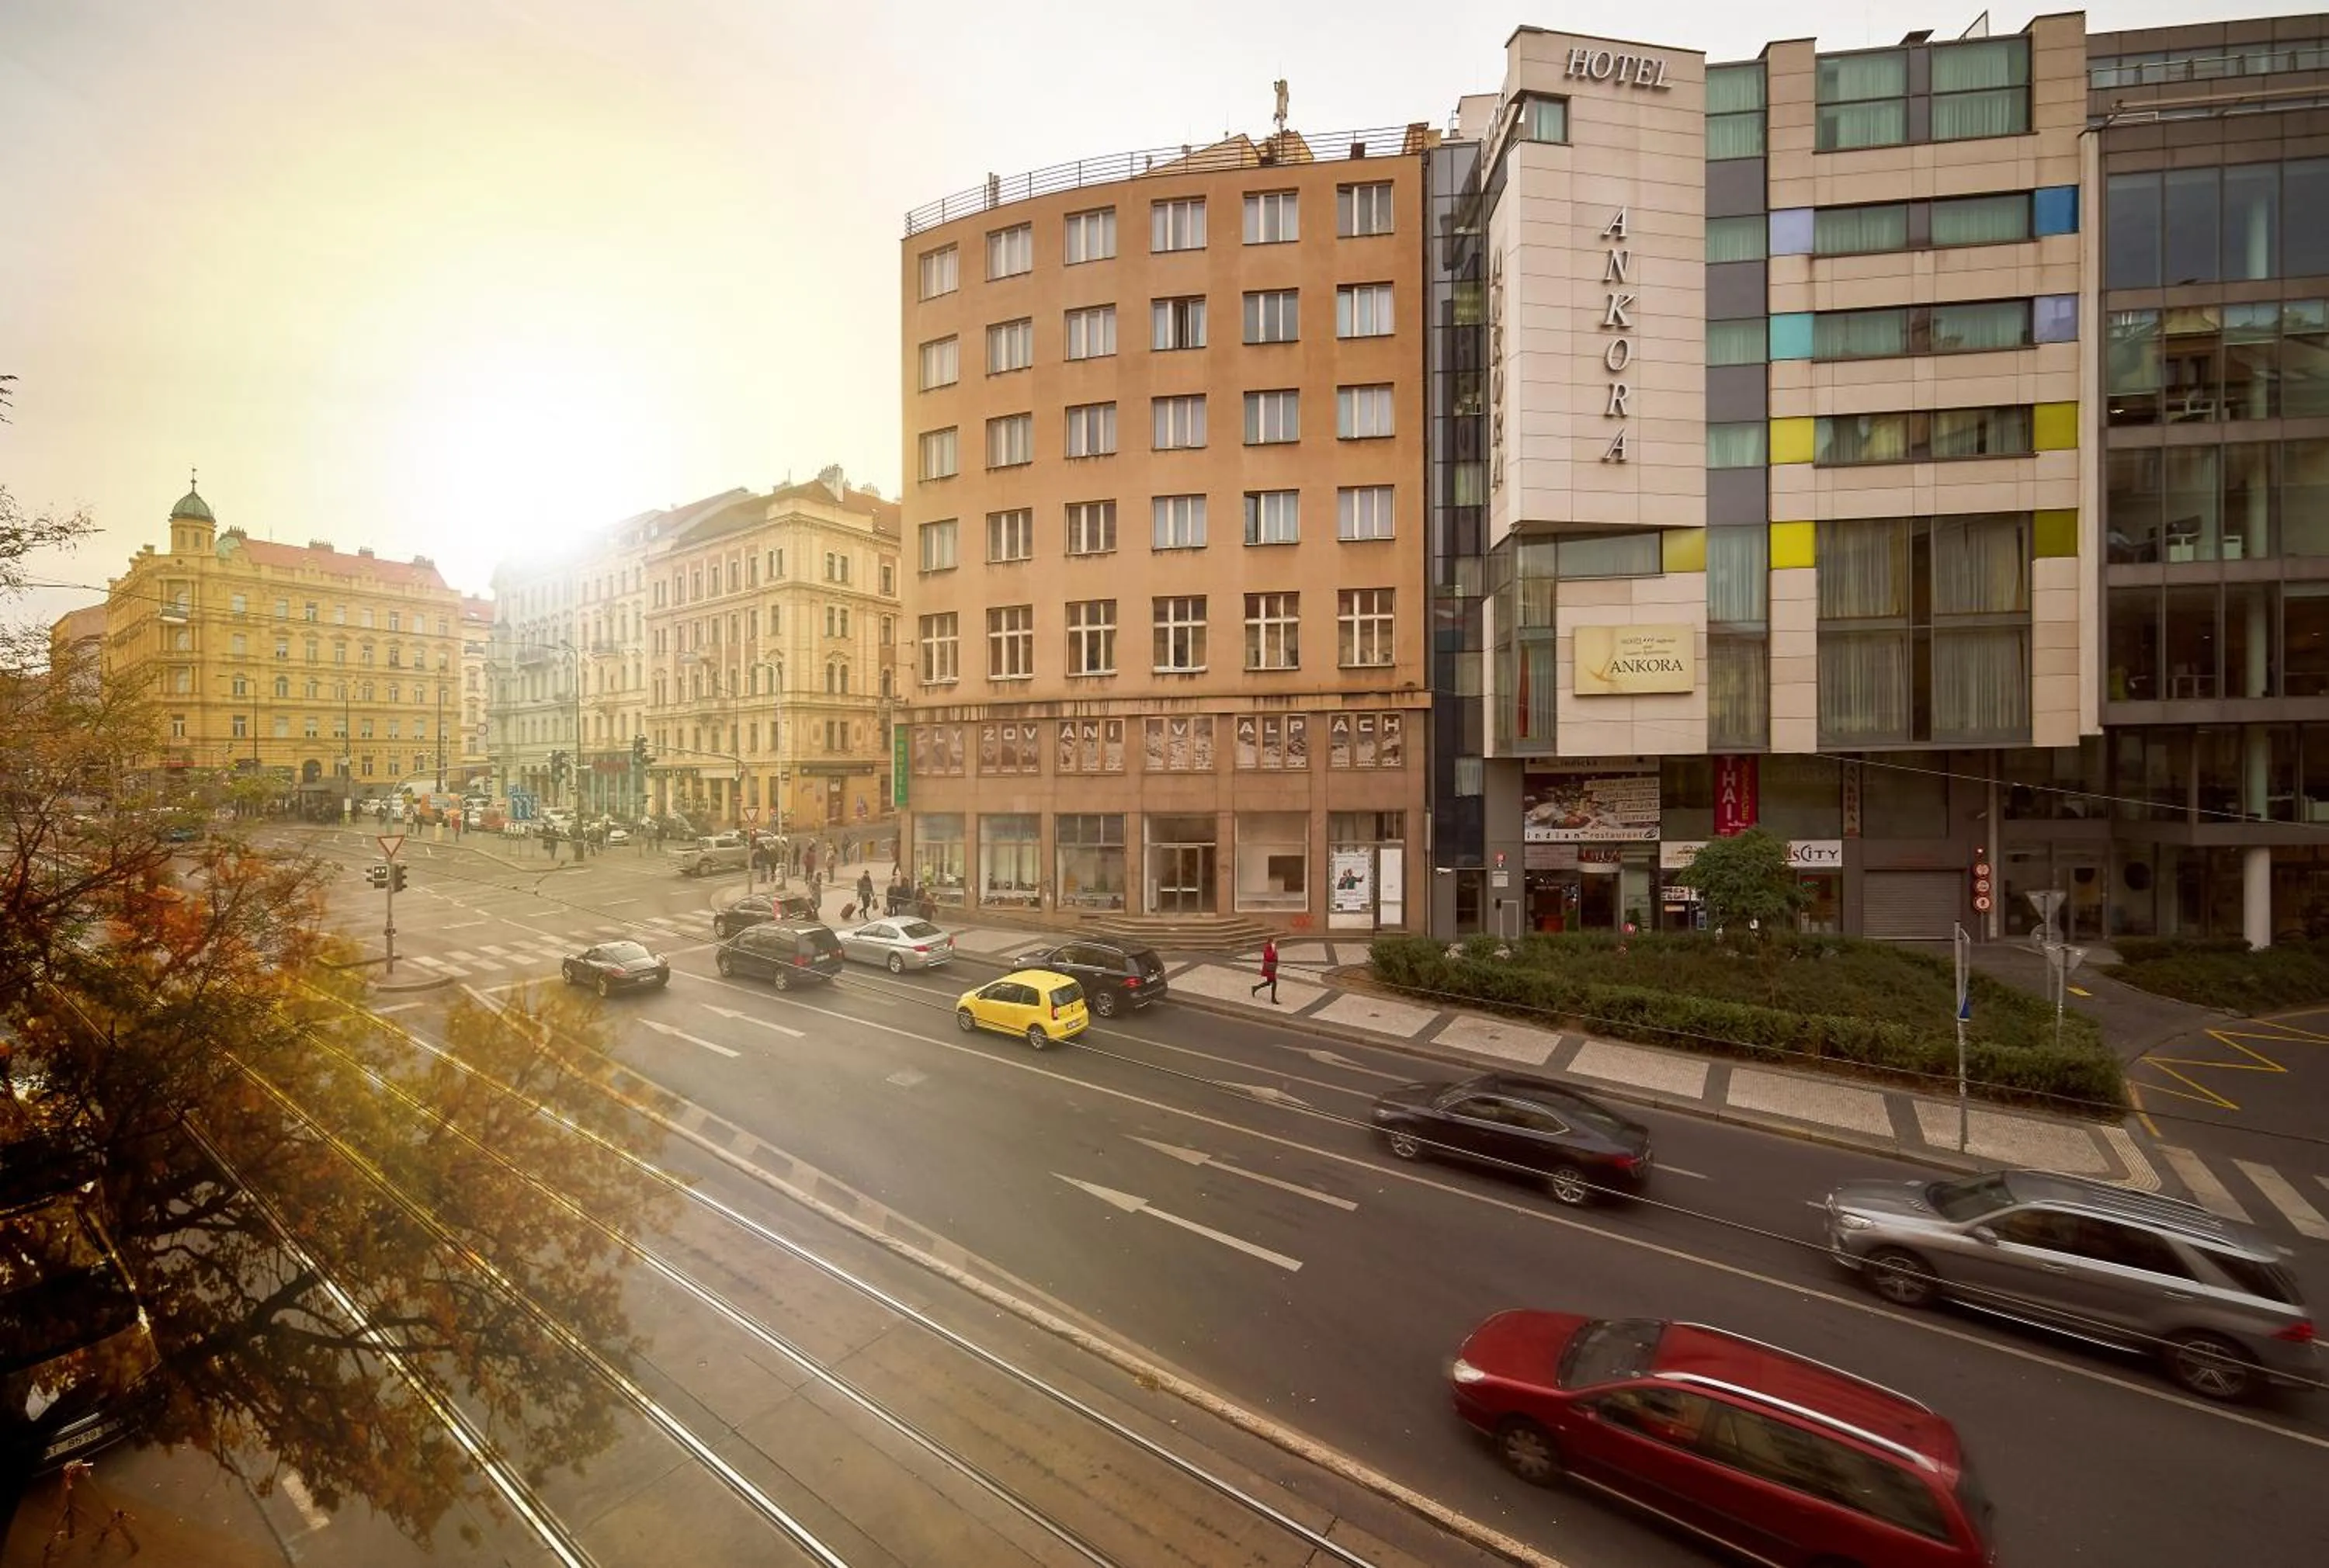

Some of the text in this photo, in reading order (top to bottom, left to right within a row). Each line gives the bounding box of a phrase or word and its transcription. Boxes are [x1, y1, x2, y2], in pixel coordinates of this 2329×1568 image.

[1565, 48, 1672, 89] HOTEL
[1601, 205, 1636, 463] ANKORA
[1610, 658, 1684, 674] ANKORA
[1171, 723, 1186, 735] V
[1722, 756, 1737, 820] THAI
